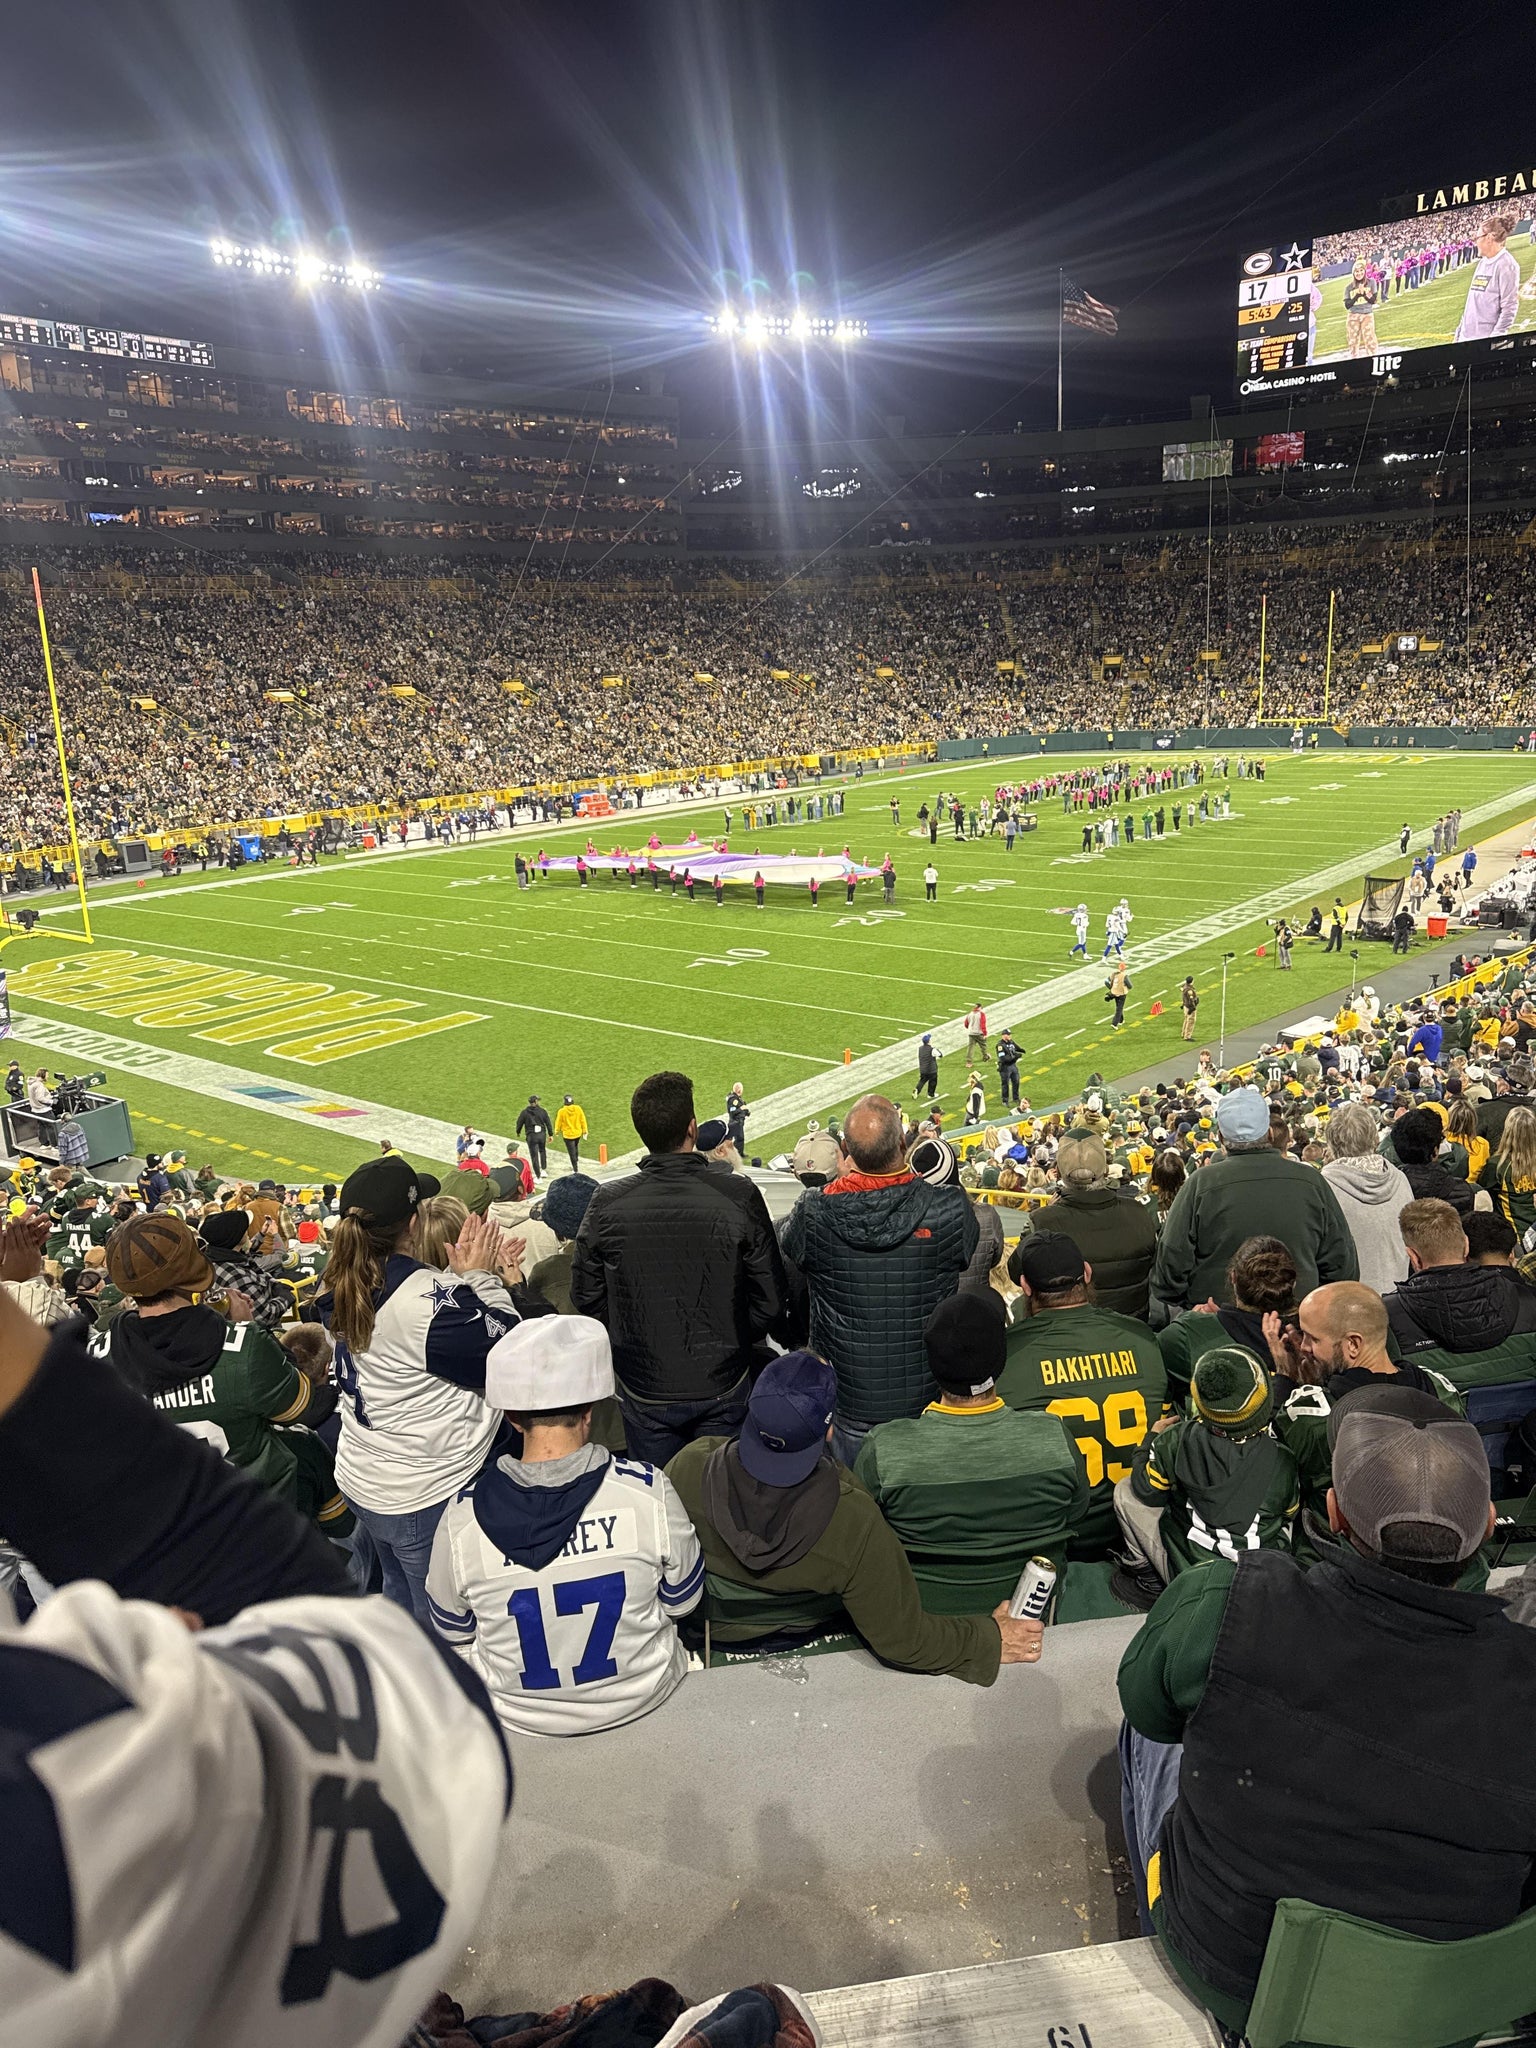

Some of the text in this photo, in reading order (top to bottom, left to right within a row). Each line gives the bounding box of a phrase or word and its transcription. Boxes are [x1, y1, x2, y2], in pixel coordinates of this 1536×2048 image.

[1248, 276, 1298, 301] 17 0
[1248, 308, 1271, 321] 5:43
[56, 322, 80, 332] PACKERS
[60, 330, 73, 342] 17
[87, 329, 118, 347] 5:43
[132, 340, 139, 352] 0
[1371, 355, 1402, 376] Lite
[1273, 377, 1305, 388] CASINO
[1310, 372, 1337, 383] HOTEL
[1400, 637, 1415, 650] 25
[841, 909, 907, 926] 20
[692, 948, 770, 967] 10
[18, 1023, 173, 1067] CRUCIAL
[1267, 1067, 1281, 1081] 10
[66, 1223, 91, 1232] FRANKLIN
[69, 1234, 94, 1258] 44
[62, 1255, 74, 1264] LOVE
[484, 1313, 507, 1338] 4
[1040, 1350, 1137, 1386] BAKHTIARI
[153, 1374, 216, 1410] ANDER
[1045, 1390, 1148, 1488] 69
[507, 1571, 627, 1691] 17
